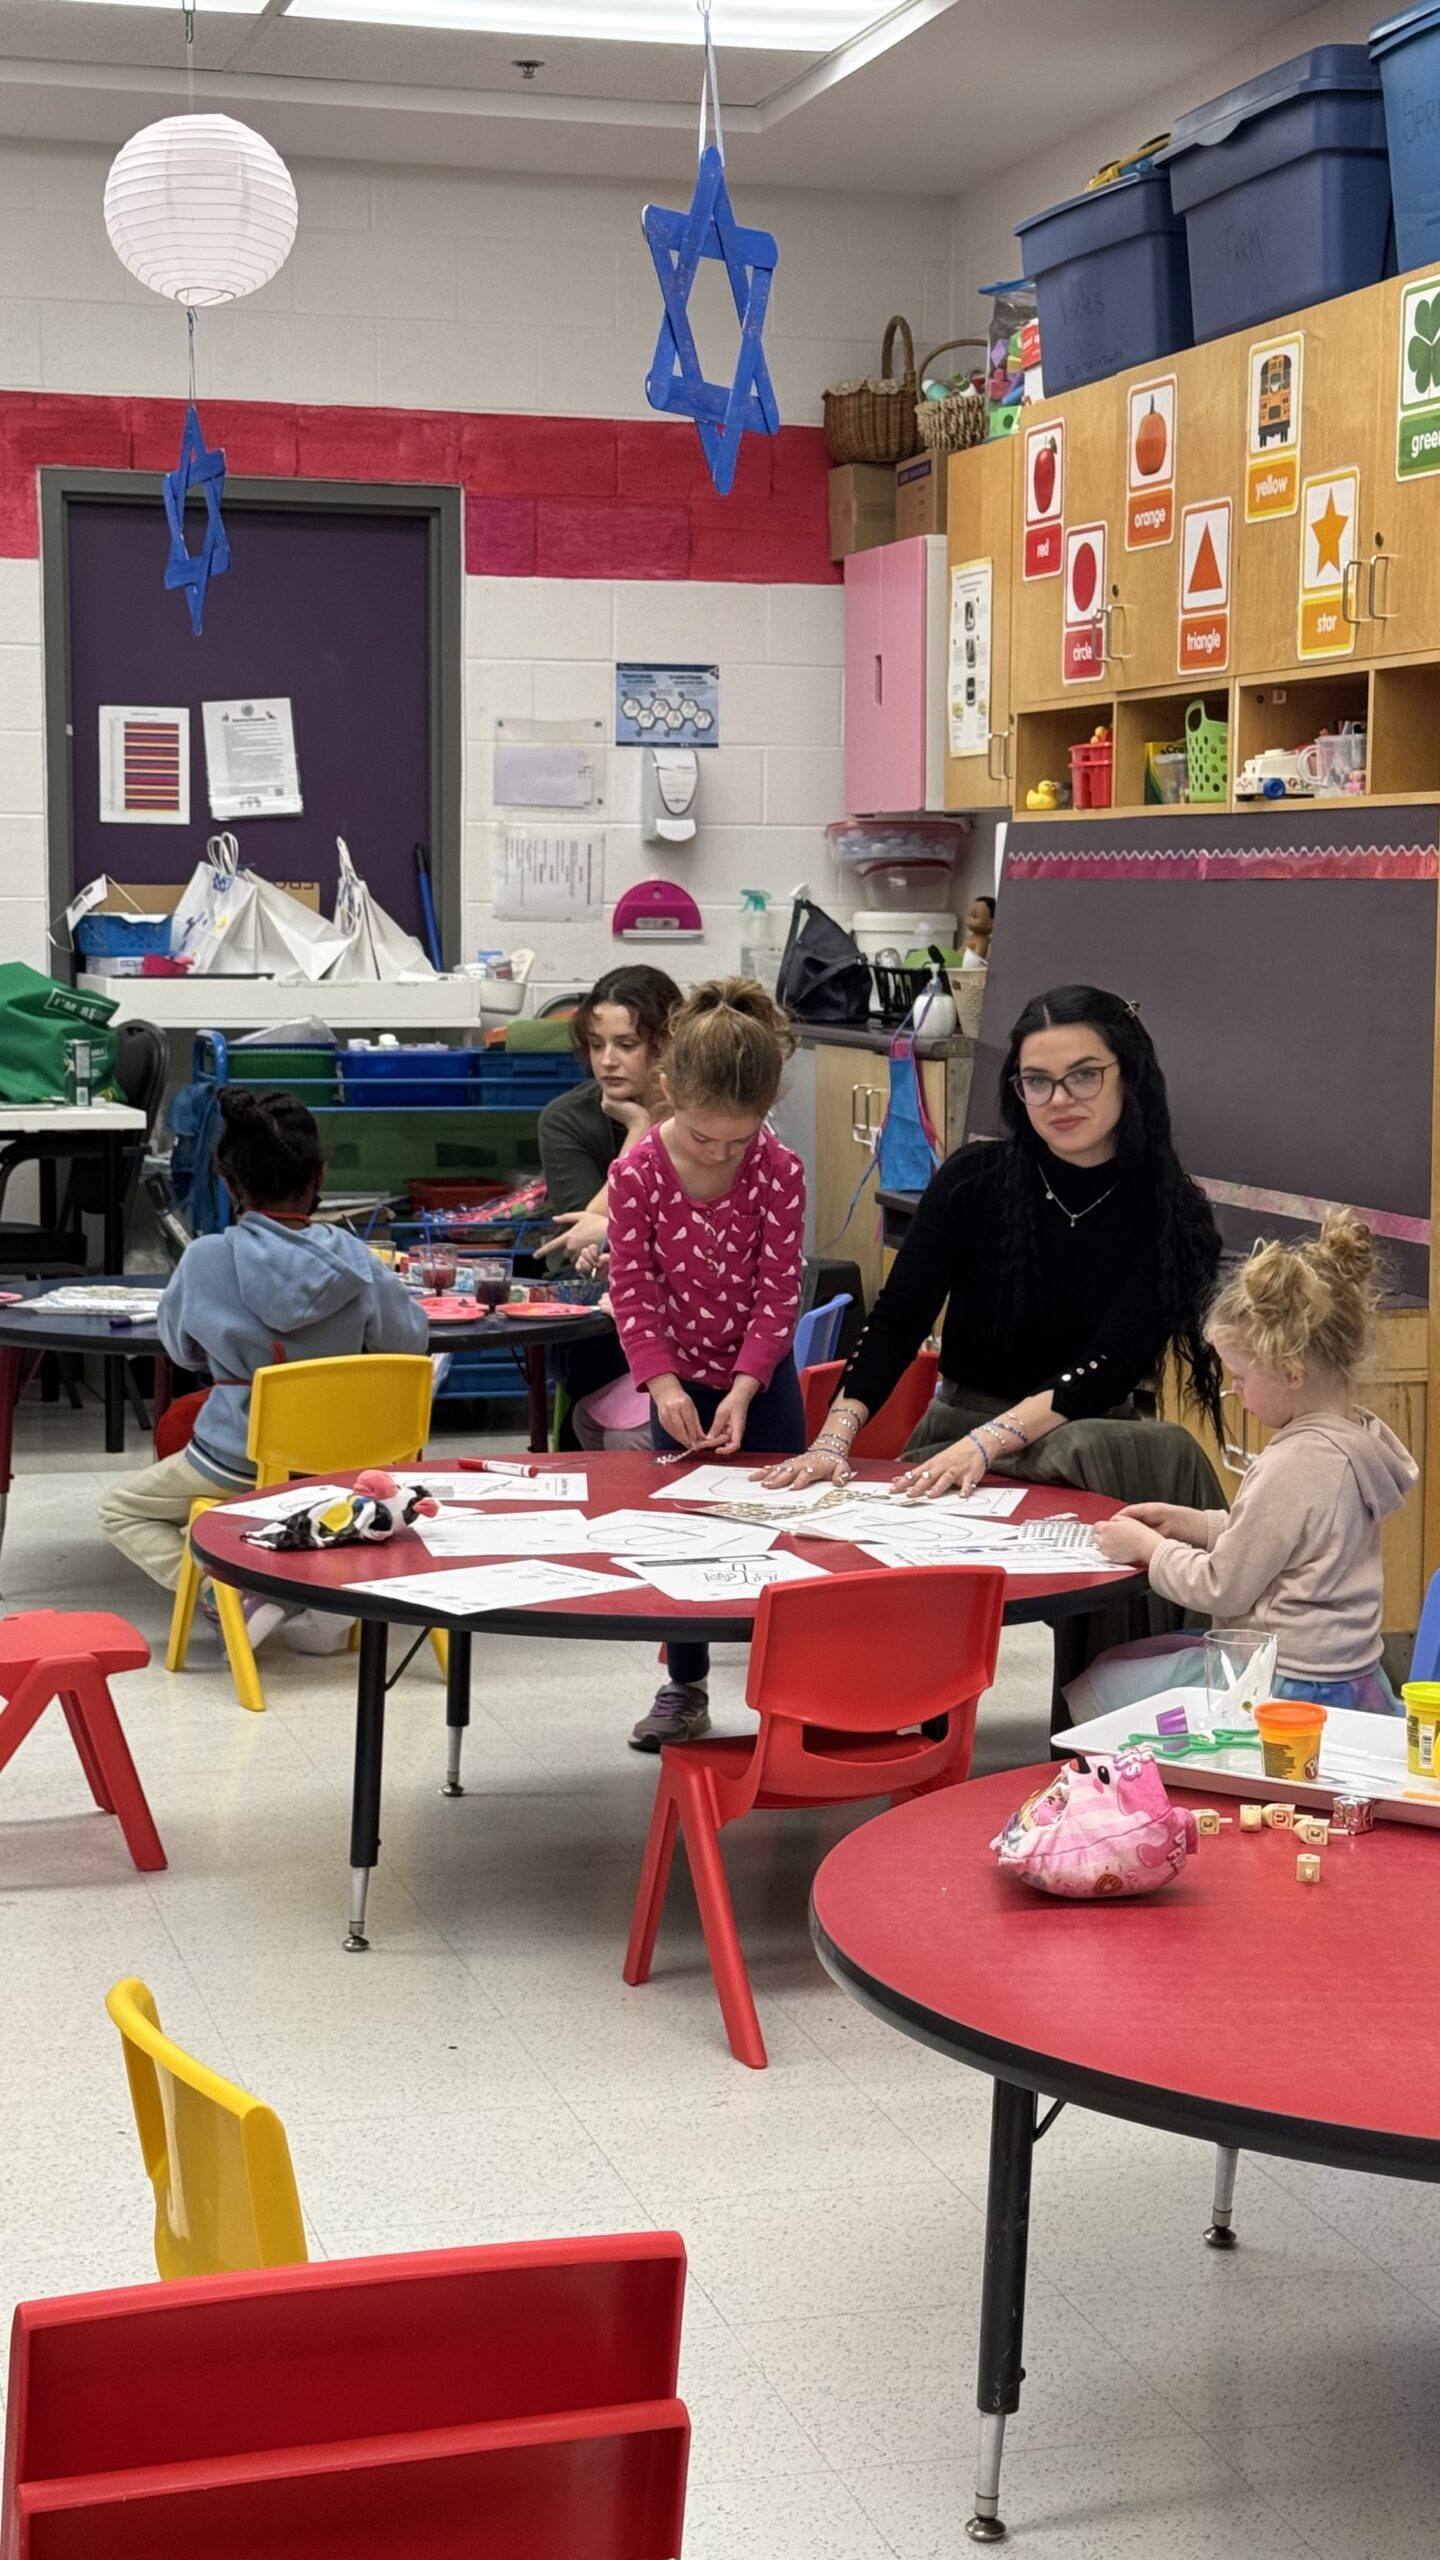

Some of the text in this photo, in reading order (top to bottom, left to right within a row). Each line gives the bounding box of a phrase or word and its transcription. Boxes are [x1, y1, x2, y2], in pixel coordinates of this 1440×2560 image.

[1255, 474, 1288, 503] yellow
[1134, 507, 1166, 529] orange
[1037, 538, 1049, 558] red
[1316, 613, 1337, 634] star
[1073, 641, 1092, 661] circle
[1187, 628, 1220, 653] triangle
[54, 998, 77, 1012] I'M
